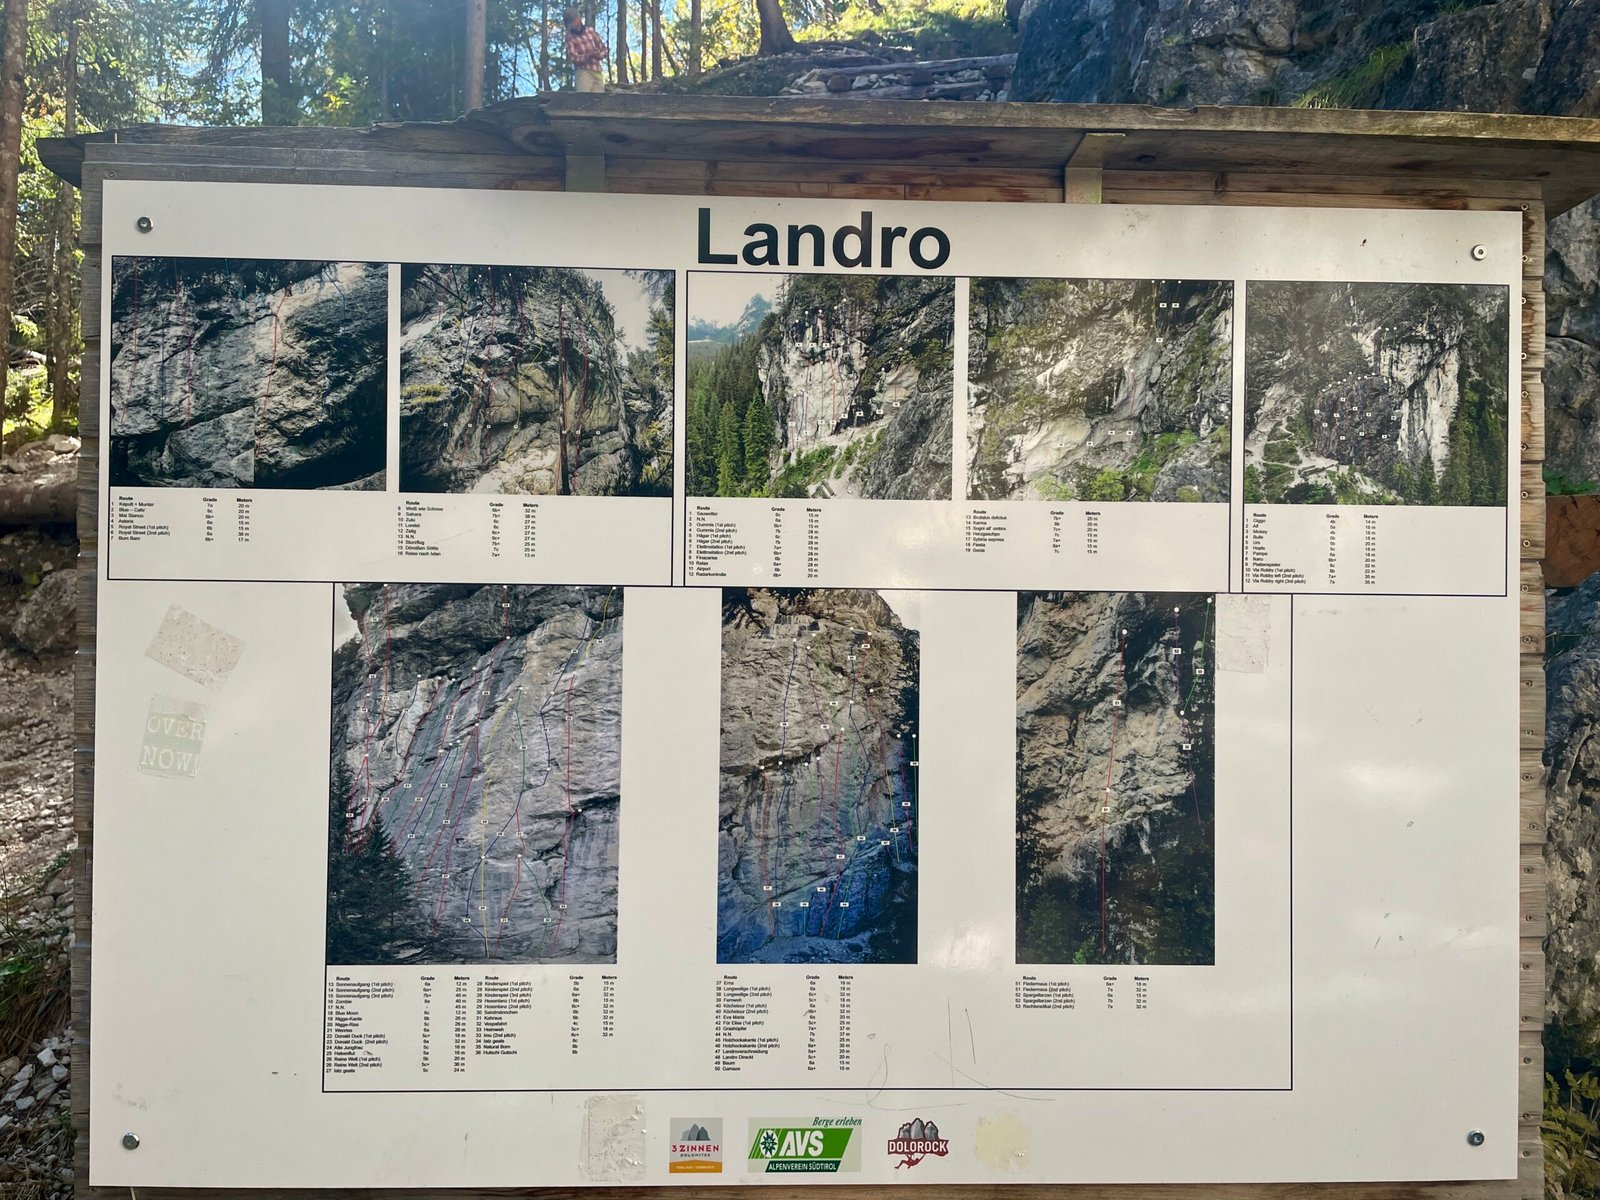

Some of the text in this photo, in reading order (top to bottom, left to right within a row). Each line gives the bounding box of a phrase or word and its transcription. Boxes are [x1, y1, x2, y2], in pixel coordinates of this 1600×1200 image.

[698, 207, 950, 270] Landro
[148, 716, 205, 741] OVER
[812, 1116, 862, 1128] Berge erleben
[779, 1130, 823, 1157] AVS
[889, 1140, 949, 1153] DOLOROCK
[768, 1160, 837, 1171] ALPENVEREIN SÜDTIROL
